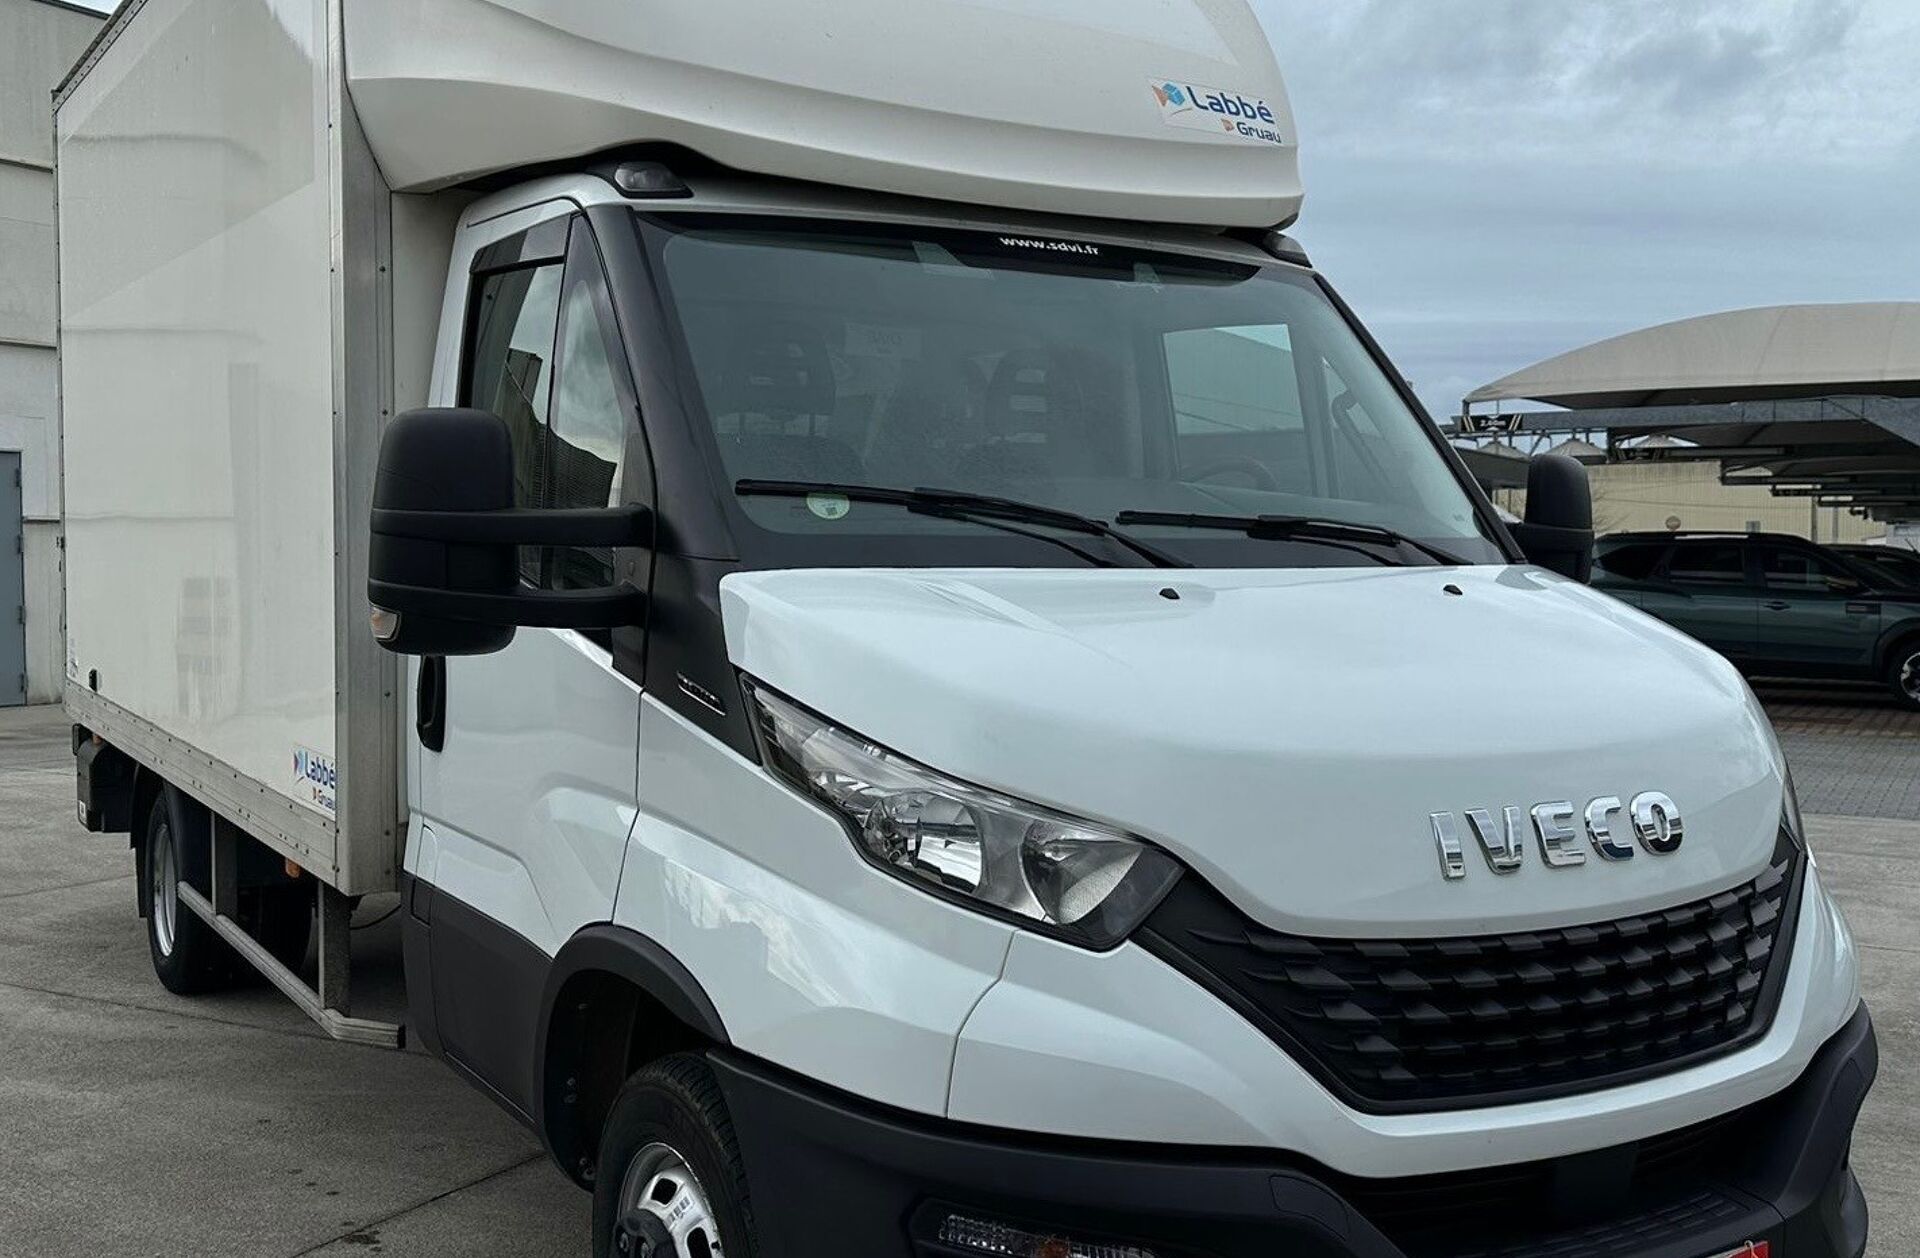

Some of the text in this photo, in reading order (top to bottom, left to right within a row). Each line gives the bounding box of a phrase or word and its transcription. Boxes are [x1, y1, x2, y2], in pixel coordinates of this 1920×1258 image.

[1186, 86, 1275, 125] Labbé
[1236, 121, 1282, 143] Gruau
[1000, 237, 1098, 255] www.sdvi.fr
[1430, 791, 1683, 881] IVECO
